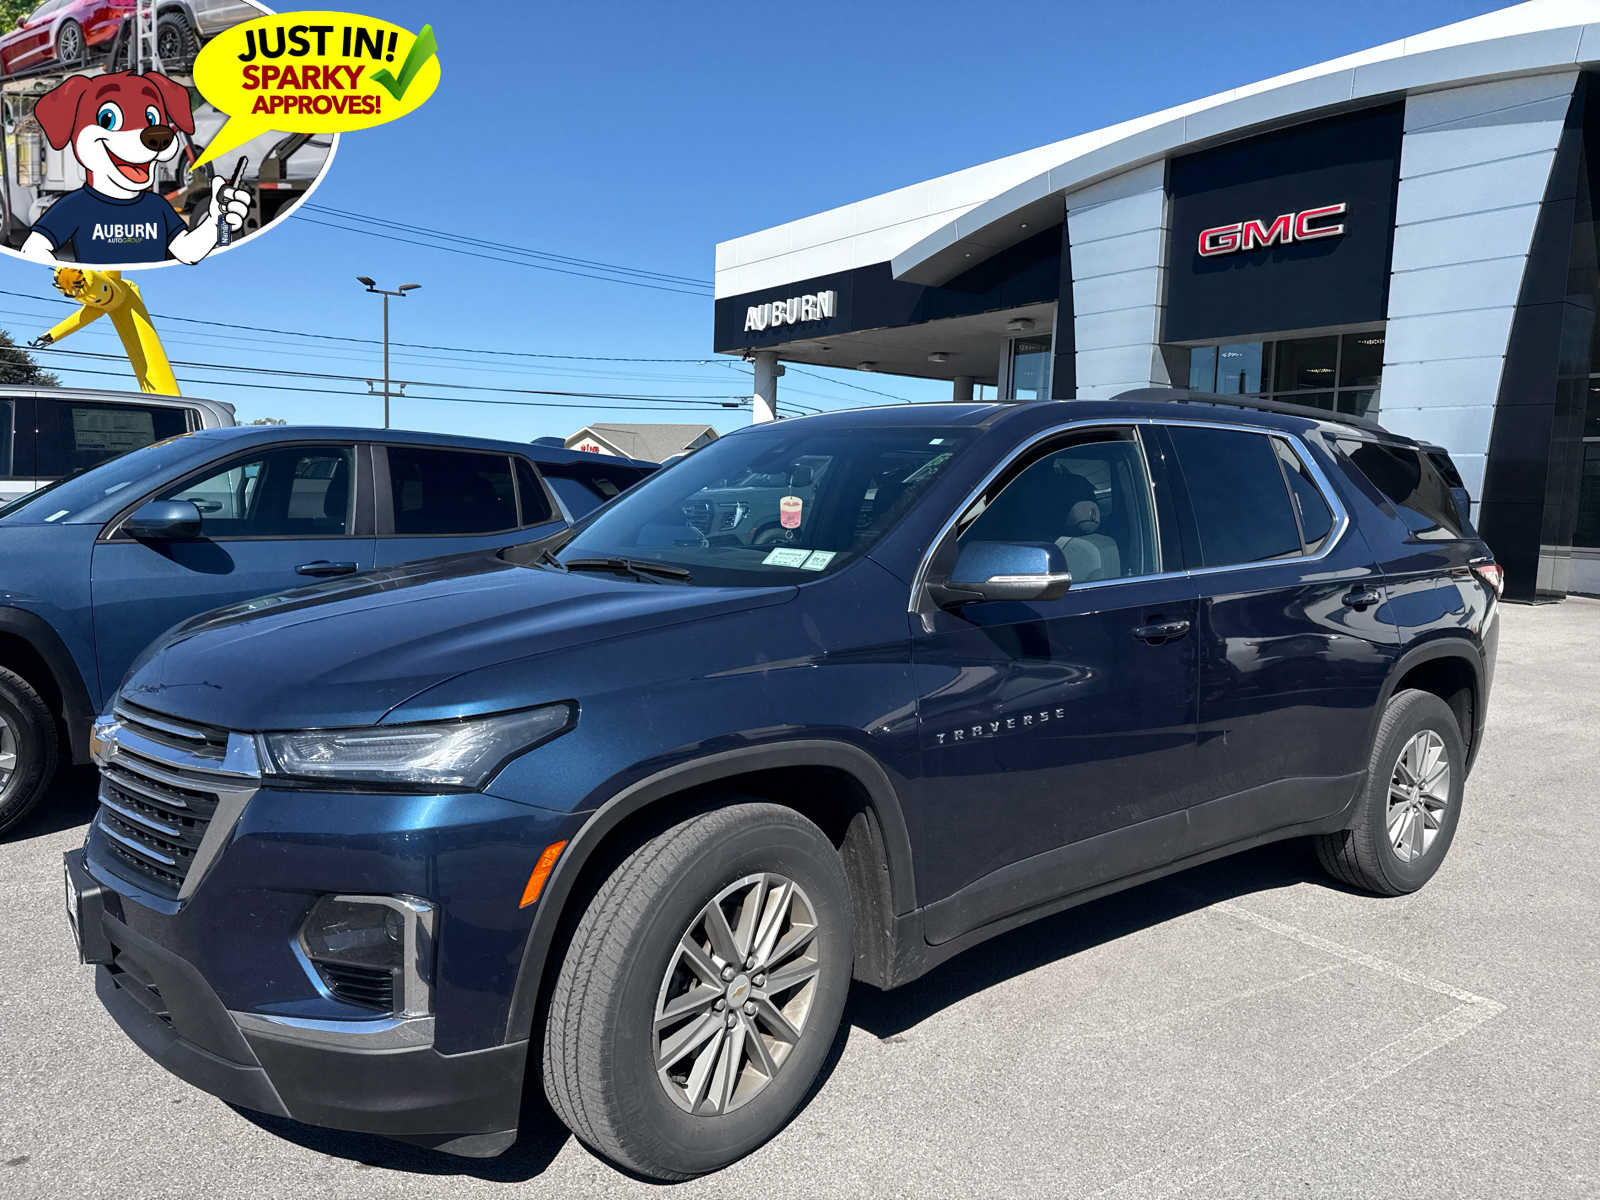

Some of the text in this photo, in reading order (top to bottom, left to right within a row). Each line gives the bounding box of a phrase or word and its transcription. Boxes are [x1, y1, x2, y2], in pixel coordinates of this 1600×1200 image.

[1199, 202, 1346, 257] GMC
[744, 290, 837, 332] AUBURN
[936, 708, 1065, 744] TRAVERSE
